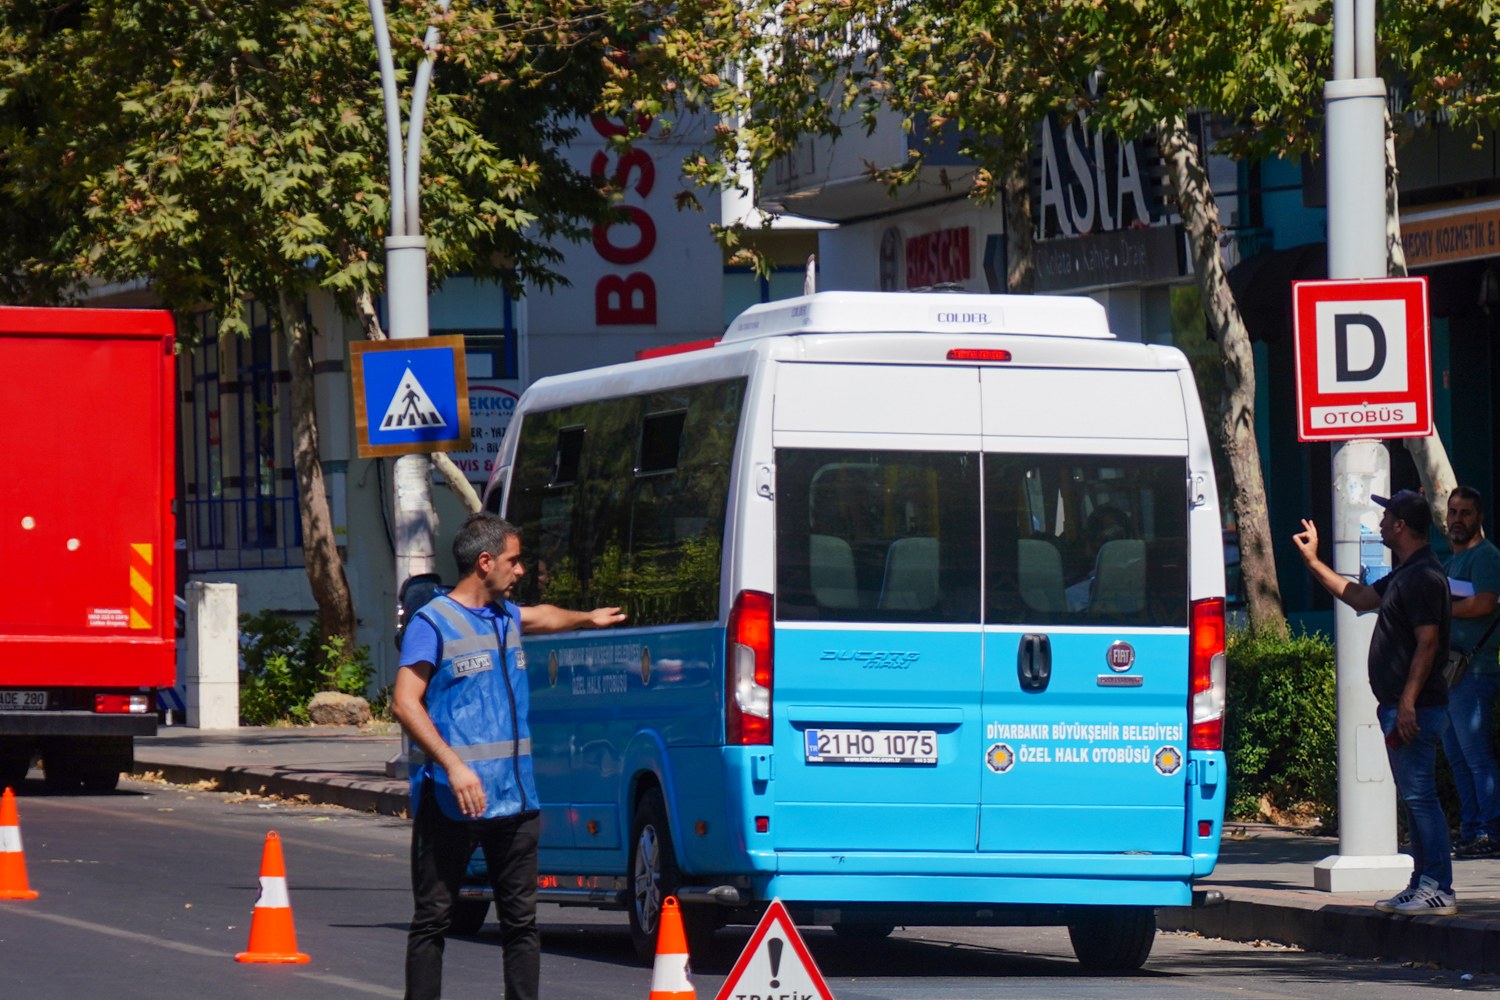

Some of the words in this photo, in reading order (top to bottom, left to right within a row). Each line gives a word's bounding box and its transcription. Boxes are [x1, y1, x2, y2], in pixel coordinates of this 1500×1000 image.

[937, 312, 988, 324] COLDER
[1334, 313, 1387, 382] D
[471, 396, 515, 410] EKKO
[1323, 407, 1404, 425] OTOBÜS
[1113, 649, 1130, 664] FIAT
[24, 692, 45, 705] 280
[986, 721, 1050, 741] DİYARBAKIR
[1052, 722, 1120, 744] BÜYÜKŞEHİR
[1122, 723, 1184, 742] BELEDİYESİ
[818, 734, 840, 755] 21
[884, 735, 935, 756] 1075
[1018, 743, 1052, 763] ÖZEL
[1055, 747, 1090, 763] HALK
[1091, 745, 1151, 764] OTOBÜSÜ
